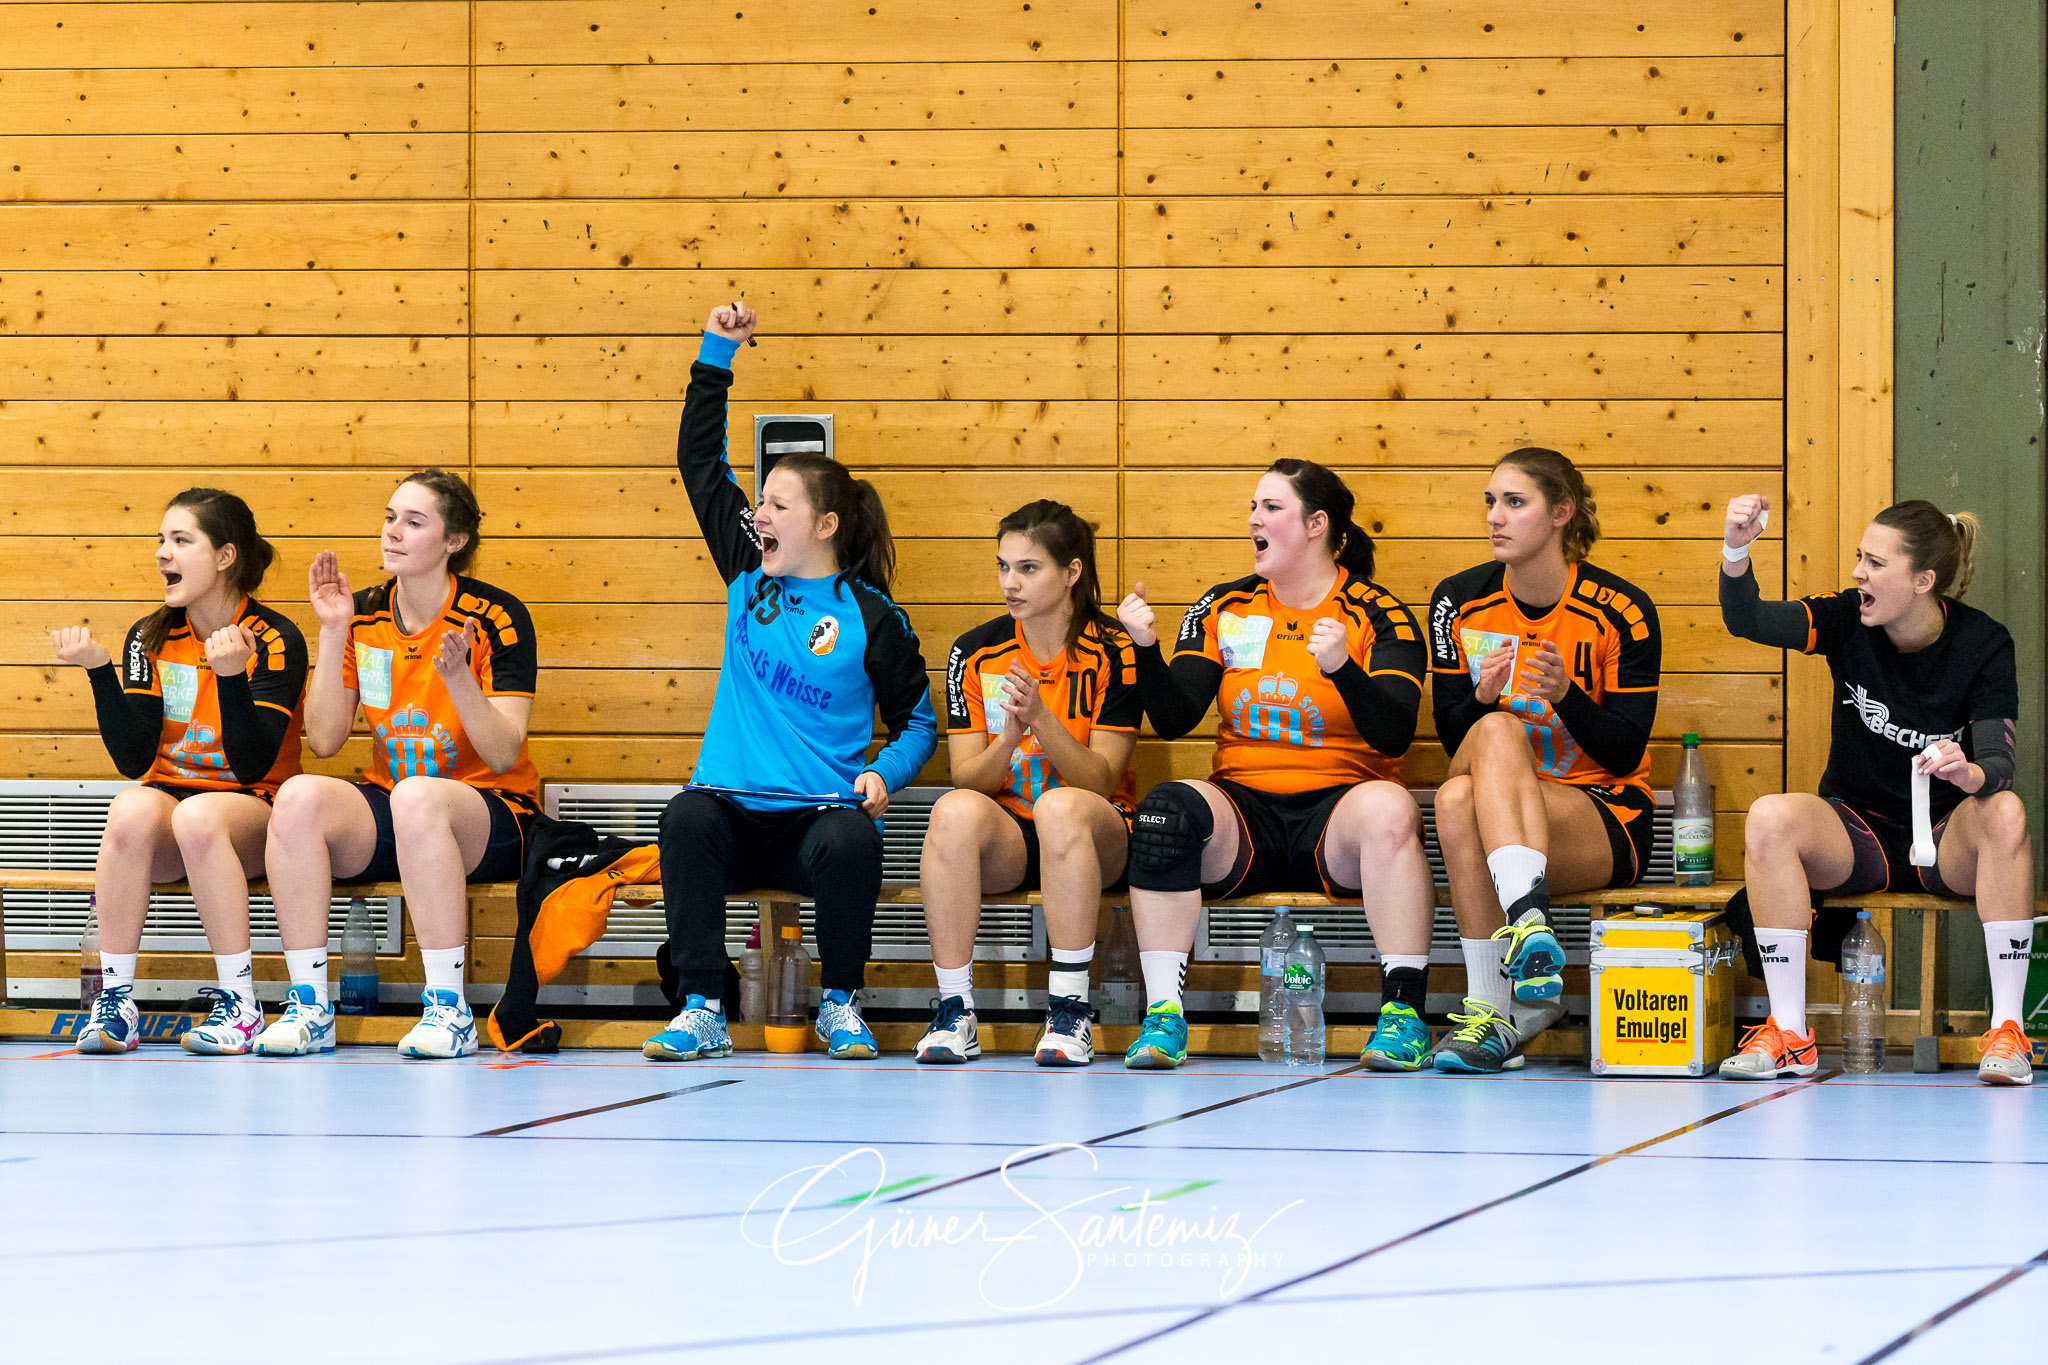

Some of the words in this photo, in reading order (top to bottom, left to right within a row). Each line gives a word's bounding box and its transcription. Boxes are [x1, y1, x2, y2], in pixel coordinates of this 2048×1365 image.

[1276, 633, 1304, 641] erima
[1463, 636, 1502, 652] STAD
[359, 650, 390, 669] TAD
[1574, 641, 1593, 692] 4
[158, 667, 198, 686] TADT
[360, 671, 390, 687] ERKE
[771, 659, 832, 709] Weisse
[162, 684, 194, 702] ERKE
[360, 689, 388, 702] reuth
[1066, 668, 1097, 719] 10
[1138, 814, 1167, 825] SELECT
[1284, 973, 1312, 985] Volvic
[1613, 988, 1688, 1012] Voltaren
[50, 1012, 192, 1038] FRUFA
[1616, 1016, 1687, 1044] Emulgel
